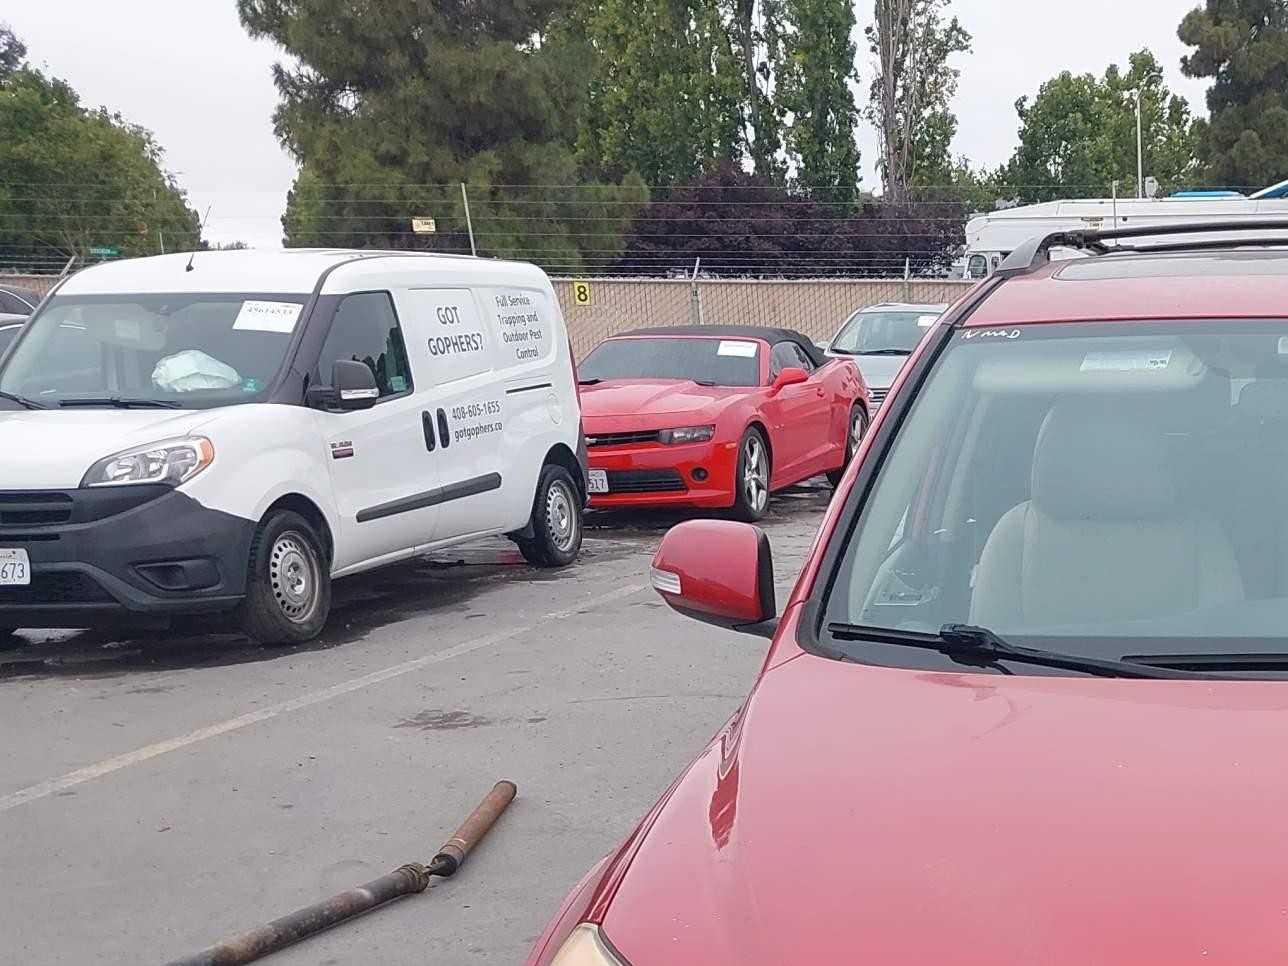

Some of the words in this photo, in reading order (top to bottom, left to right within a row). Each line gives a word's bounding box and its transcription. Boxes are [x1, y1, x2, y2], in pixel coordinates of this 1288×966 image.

[495, 295, 508, 308] Full
[507, 293, 531, 307] Service
[577, 284, 589, 303] 8
[436, 305, 460, 325] GOT
[497, 313, 527, 327] Trapping
[526, 310, 539, 323] and
[427, 332, 484, 357] GOPHERS?
[502, 330, 529, 343] Outdoor
[528, 328, 543, 341] Pest
[515, 345, 539, 360] Control
[452, 400, 501, 420] 408-605-1655
